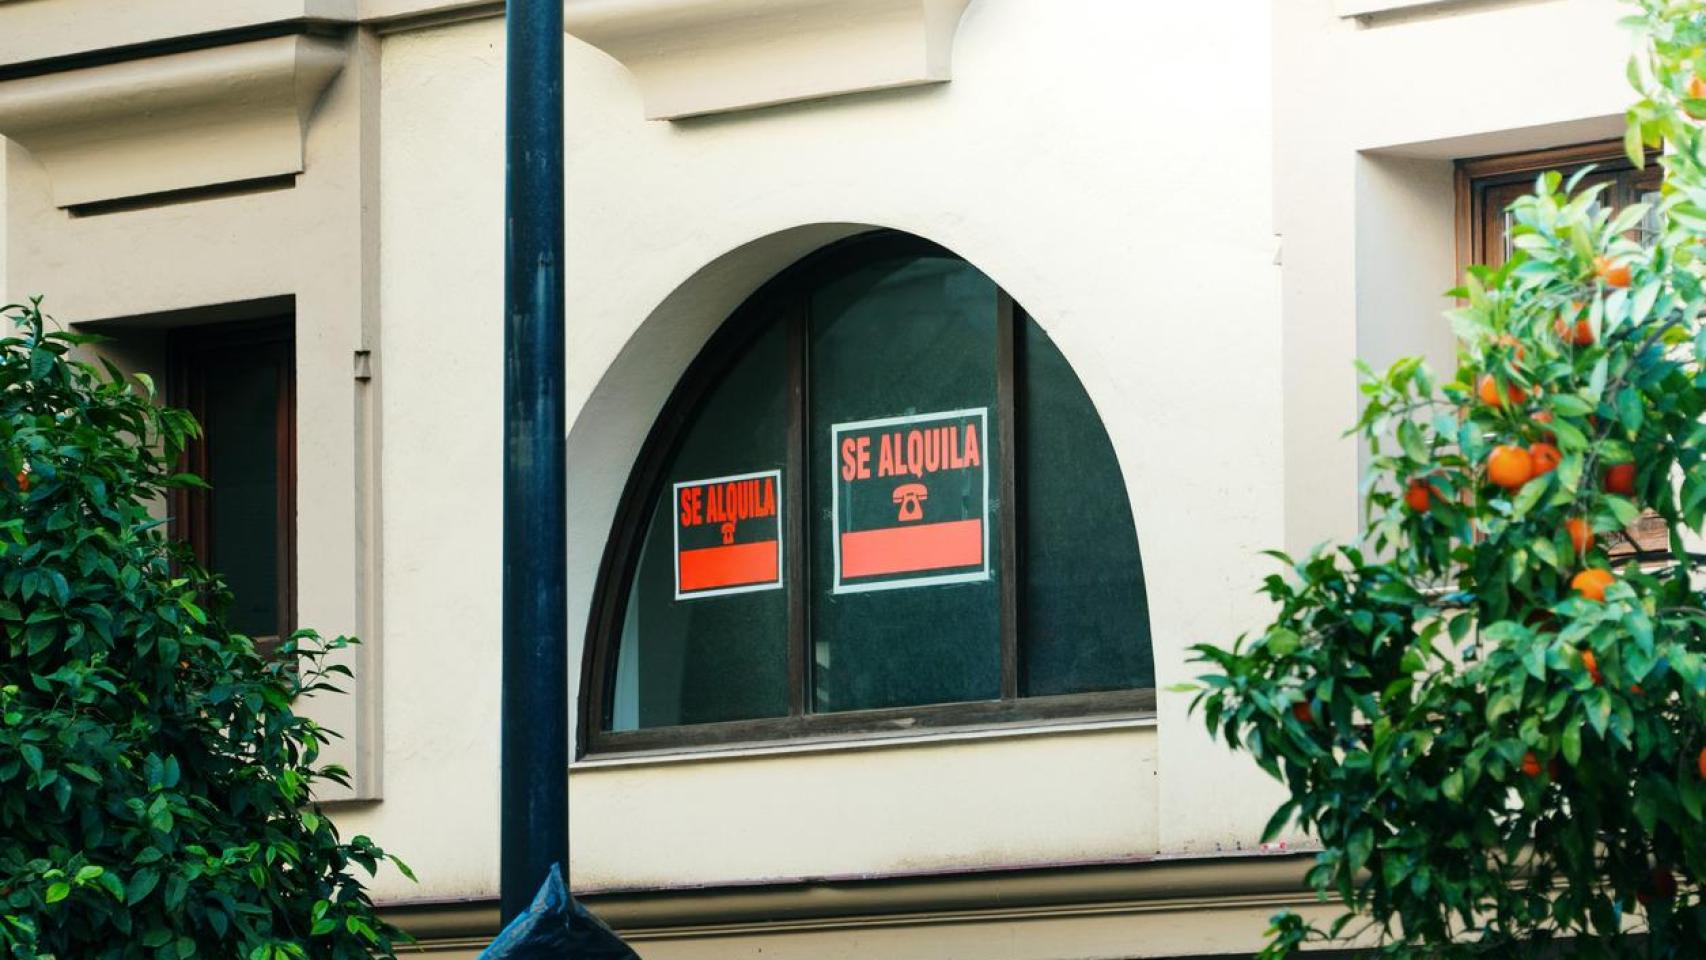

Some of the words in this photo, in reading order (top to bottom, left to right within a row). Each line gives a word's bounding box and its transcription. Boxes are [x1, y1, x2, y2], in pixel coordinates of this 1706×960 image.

[841, 436, 870, 481] SE
[878, 424, 980, 478] ALQUILA
[680, 487, 702, 527] SE
[706, 479, 775, 524] ALQUILA
